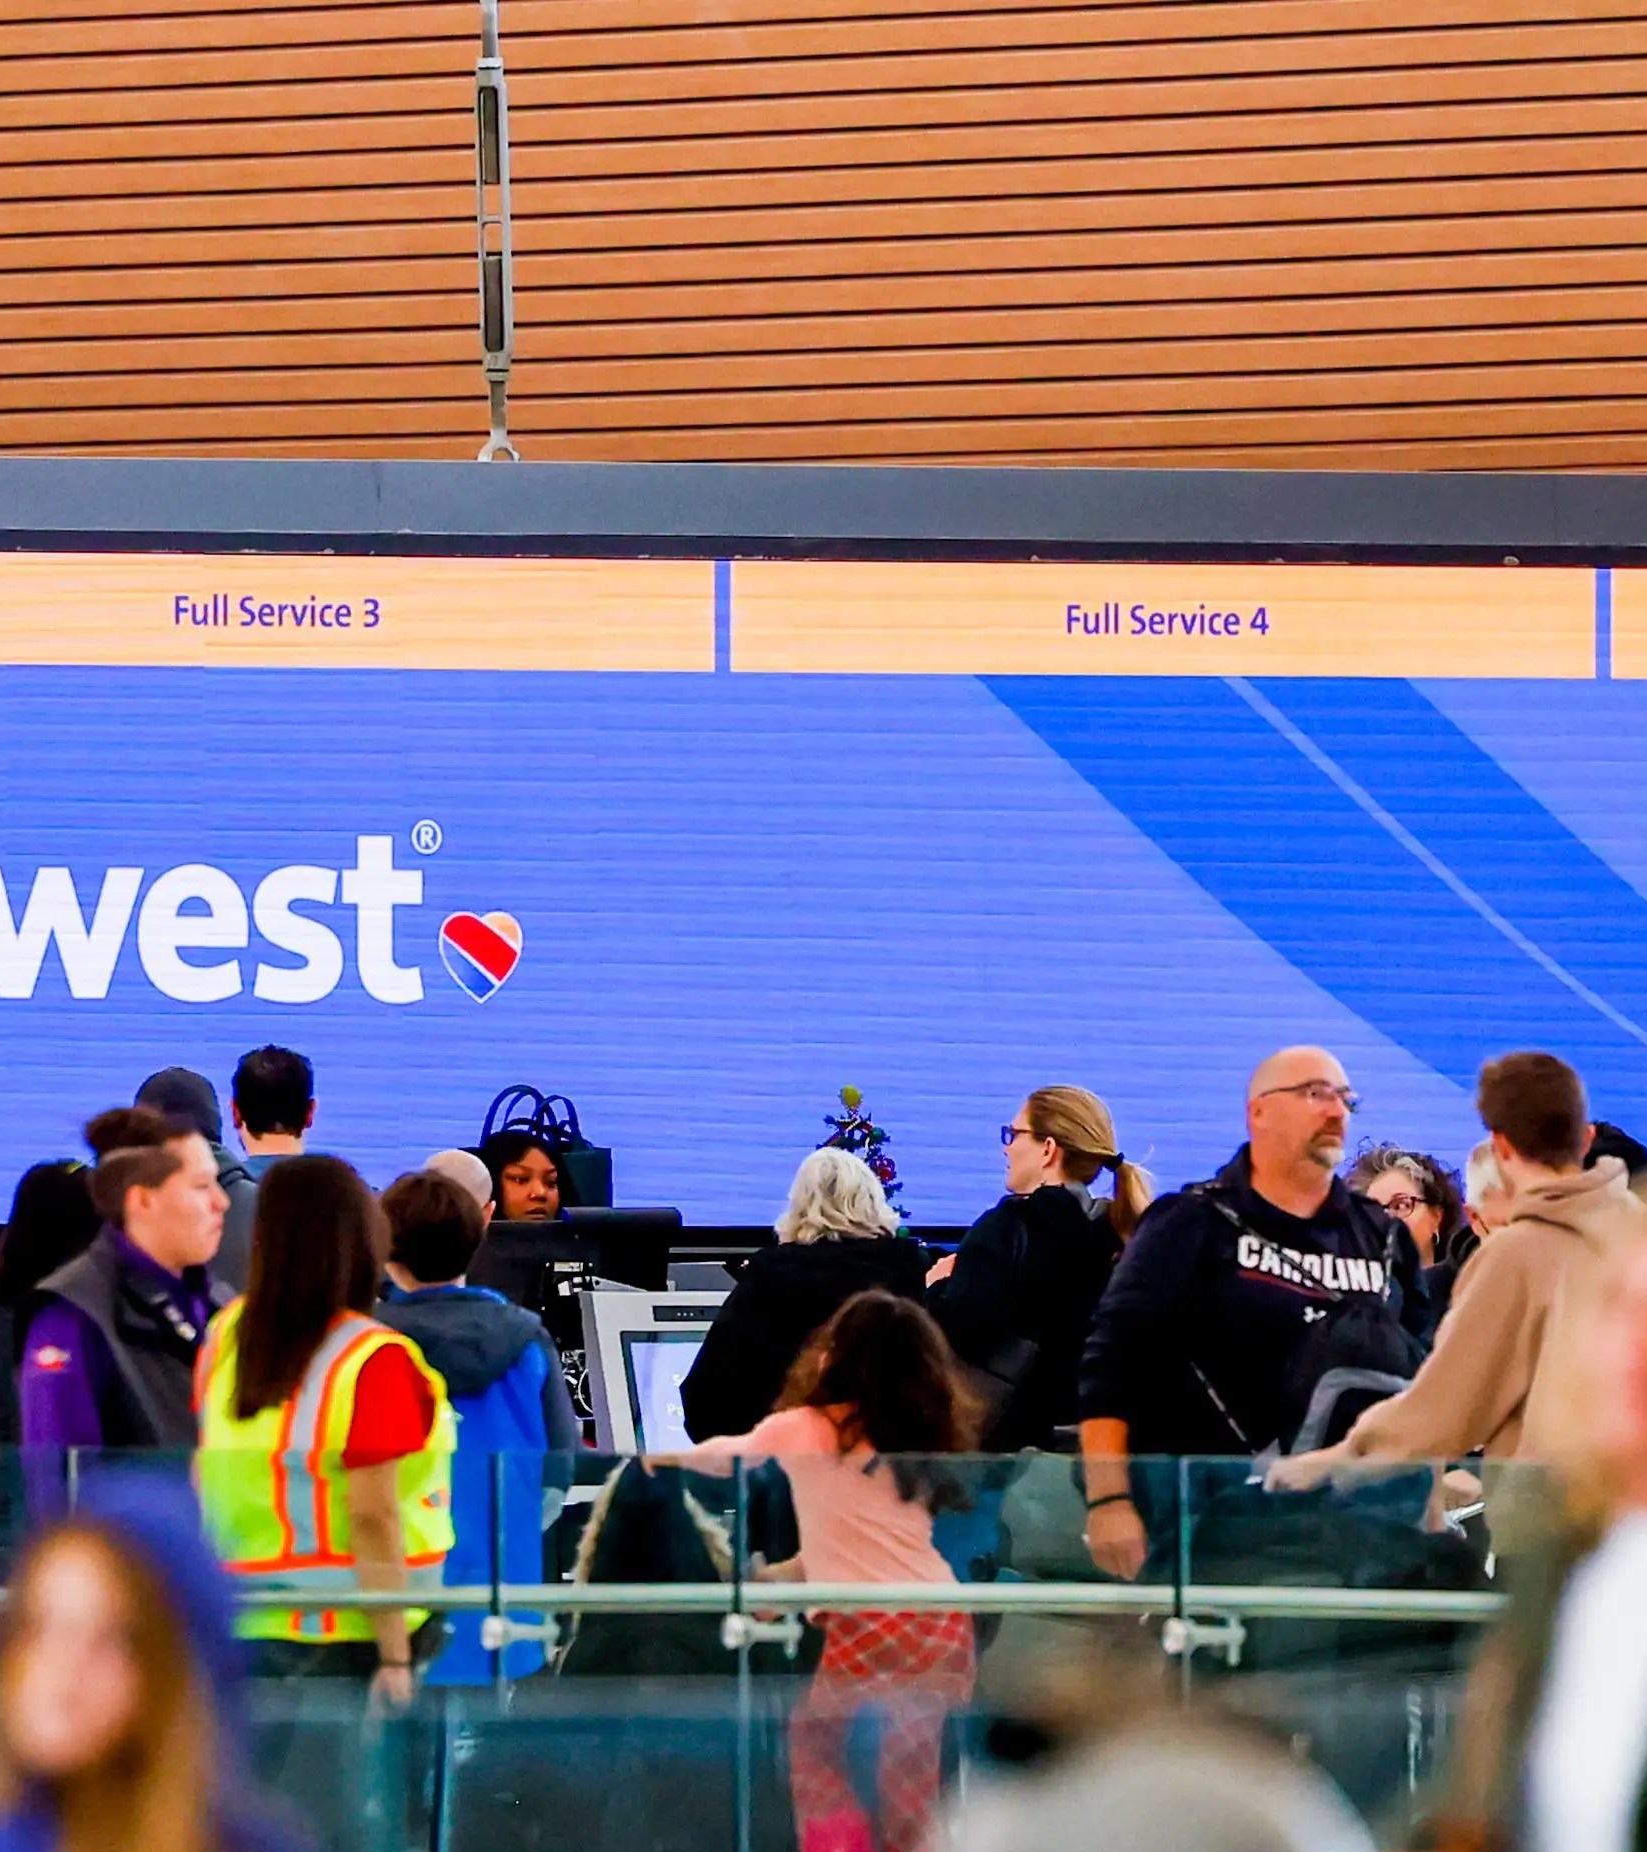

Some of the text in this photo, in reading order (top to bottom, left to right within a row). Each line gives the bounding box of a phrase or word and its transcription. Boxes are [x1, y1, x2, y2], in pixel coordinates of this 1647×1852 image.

[173, 593, 380, 628] Full Service 3
[1065, 602, 1270, 636] Full Service 4
